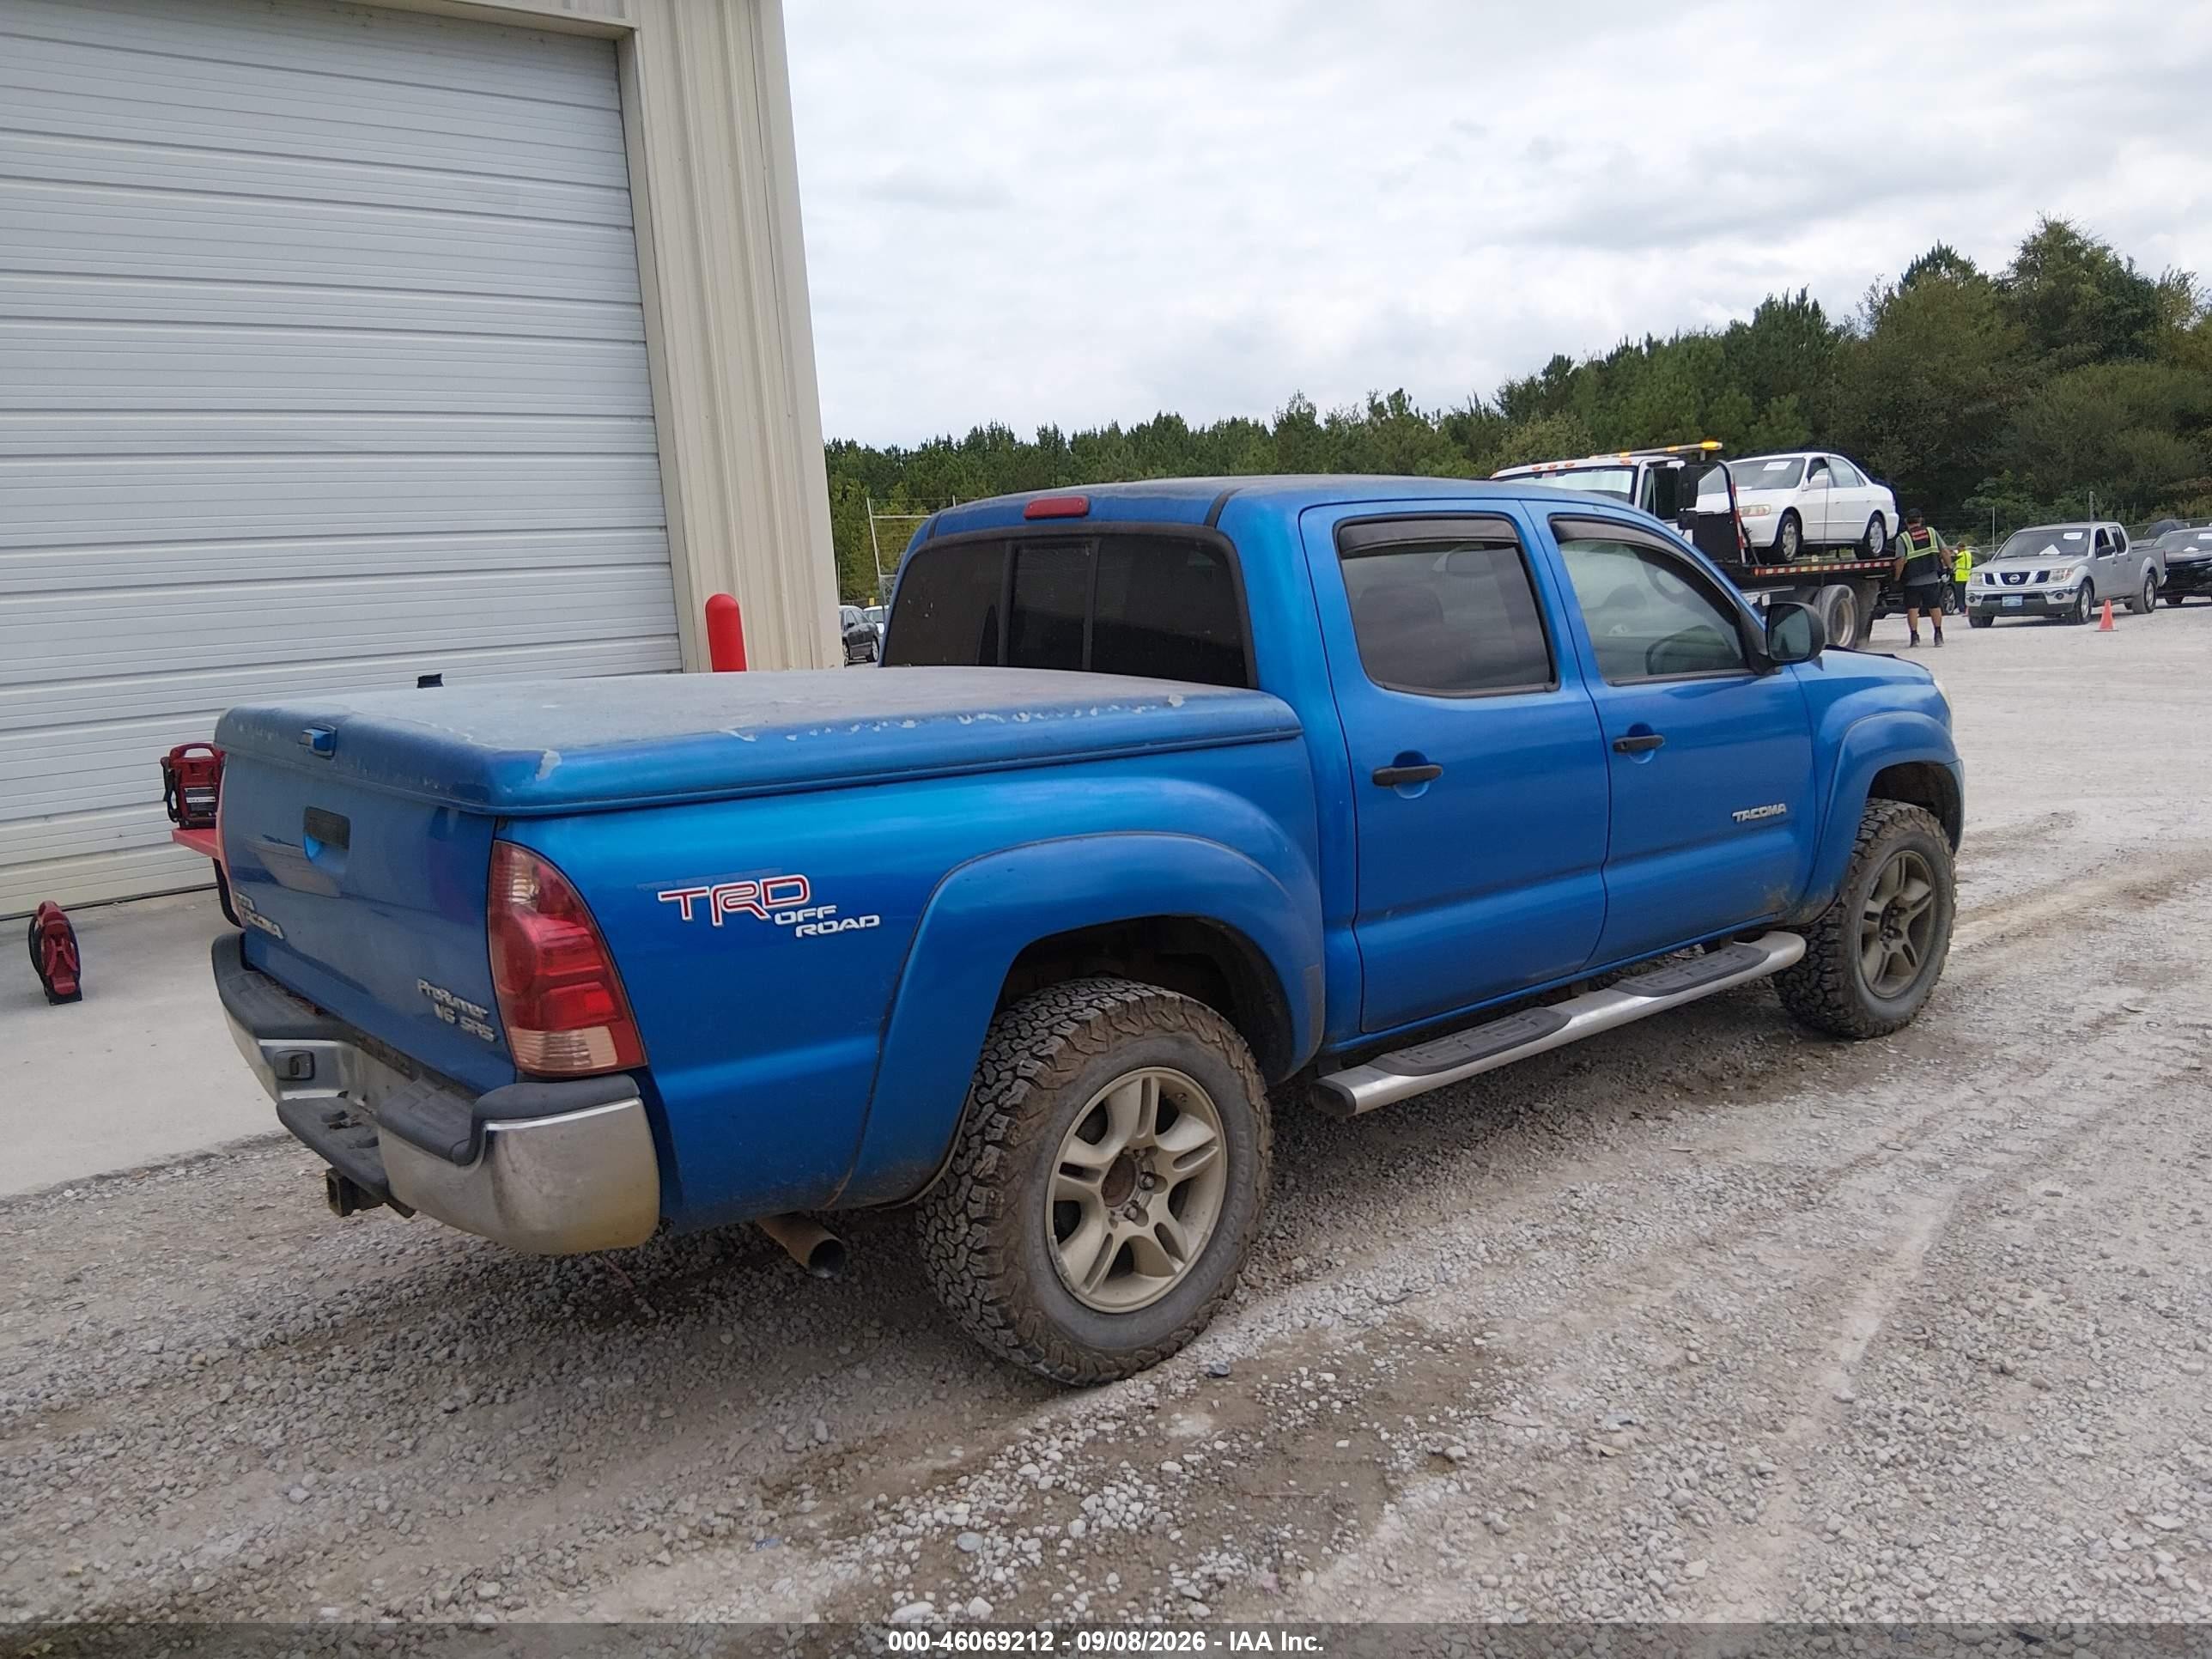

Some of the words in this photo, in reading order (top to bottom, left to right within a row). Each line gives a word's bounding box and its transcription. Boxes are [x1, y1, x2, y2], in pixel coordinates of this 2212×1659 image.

[1732, 803, 1786, 823] TACOMA
[658, 873, 811, 927] TRD
[775, 904, 837, 925] OFF
[795, 915, 881, 938] ROAD
[434, 1003, 456, 1024] V6
[460, 1016, 495, 1042] SR5
